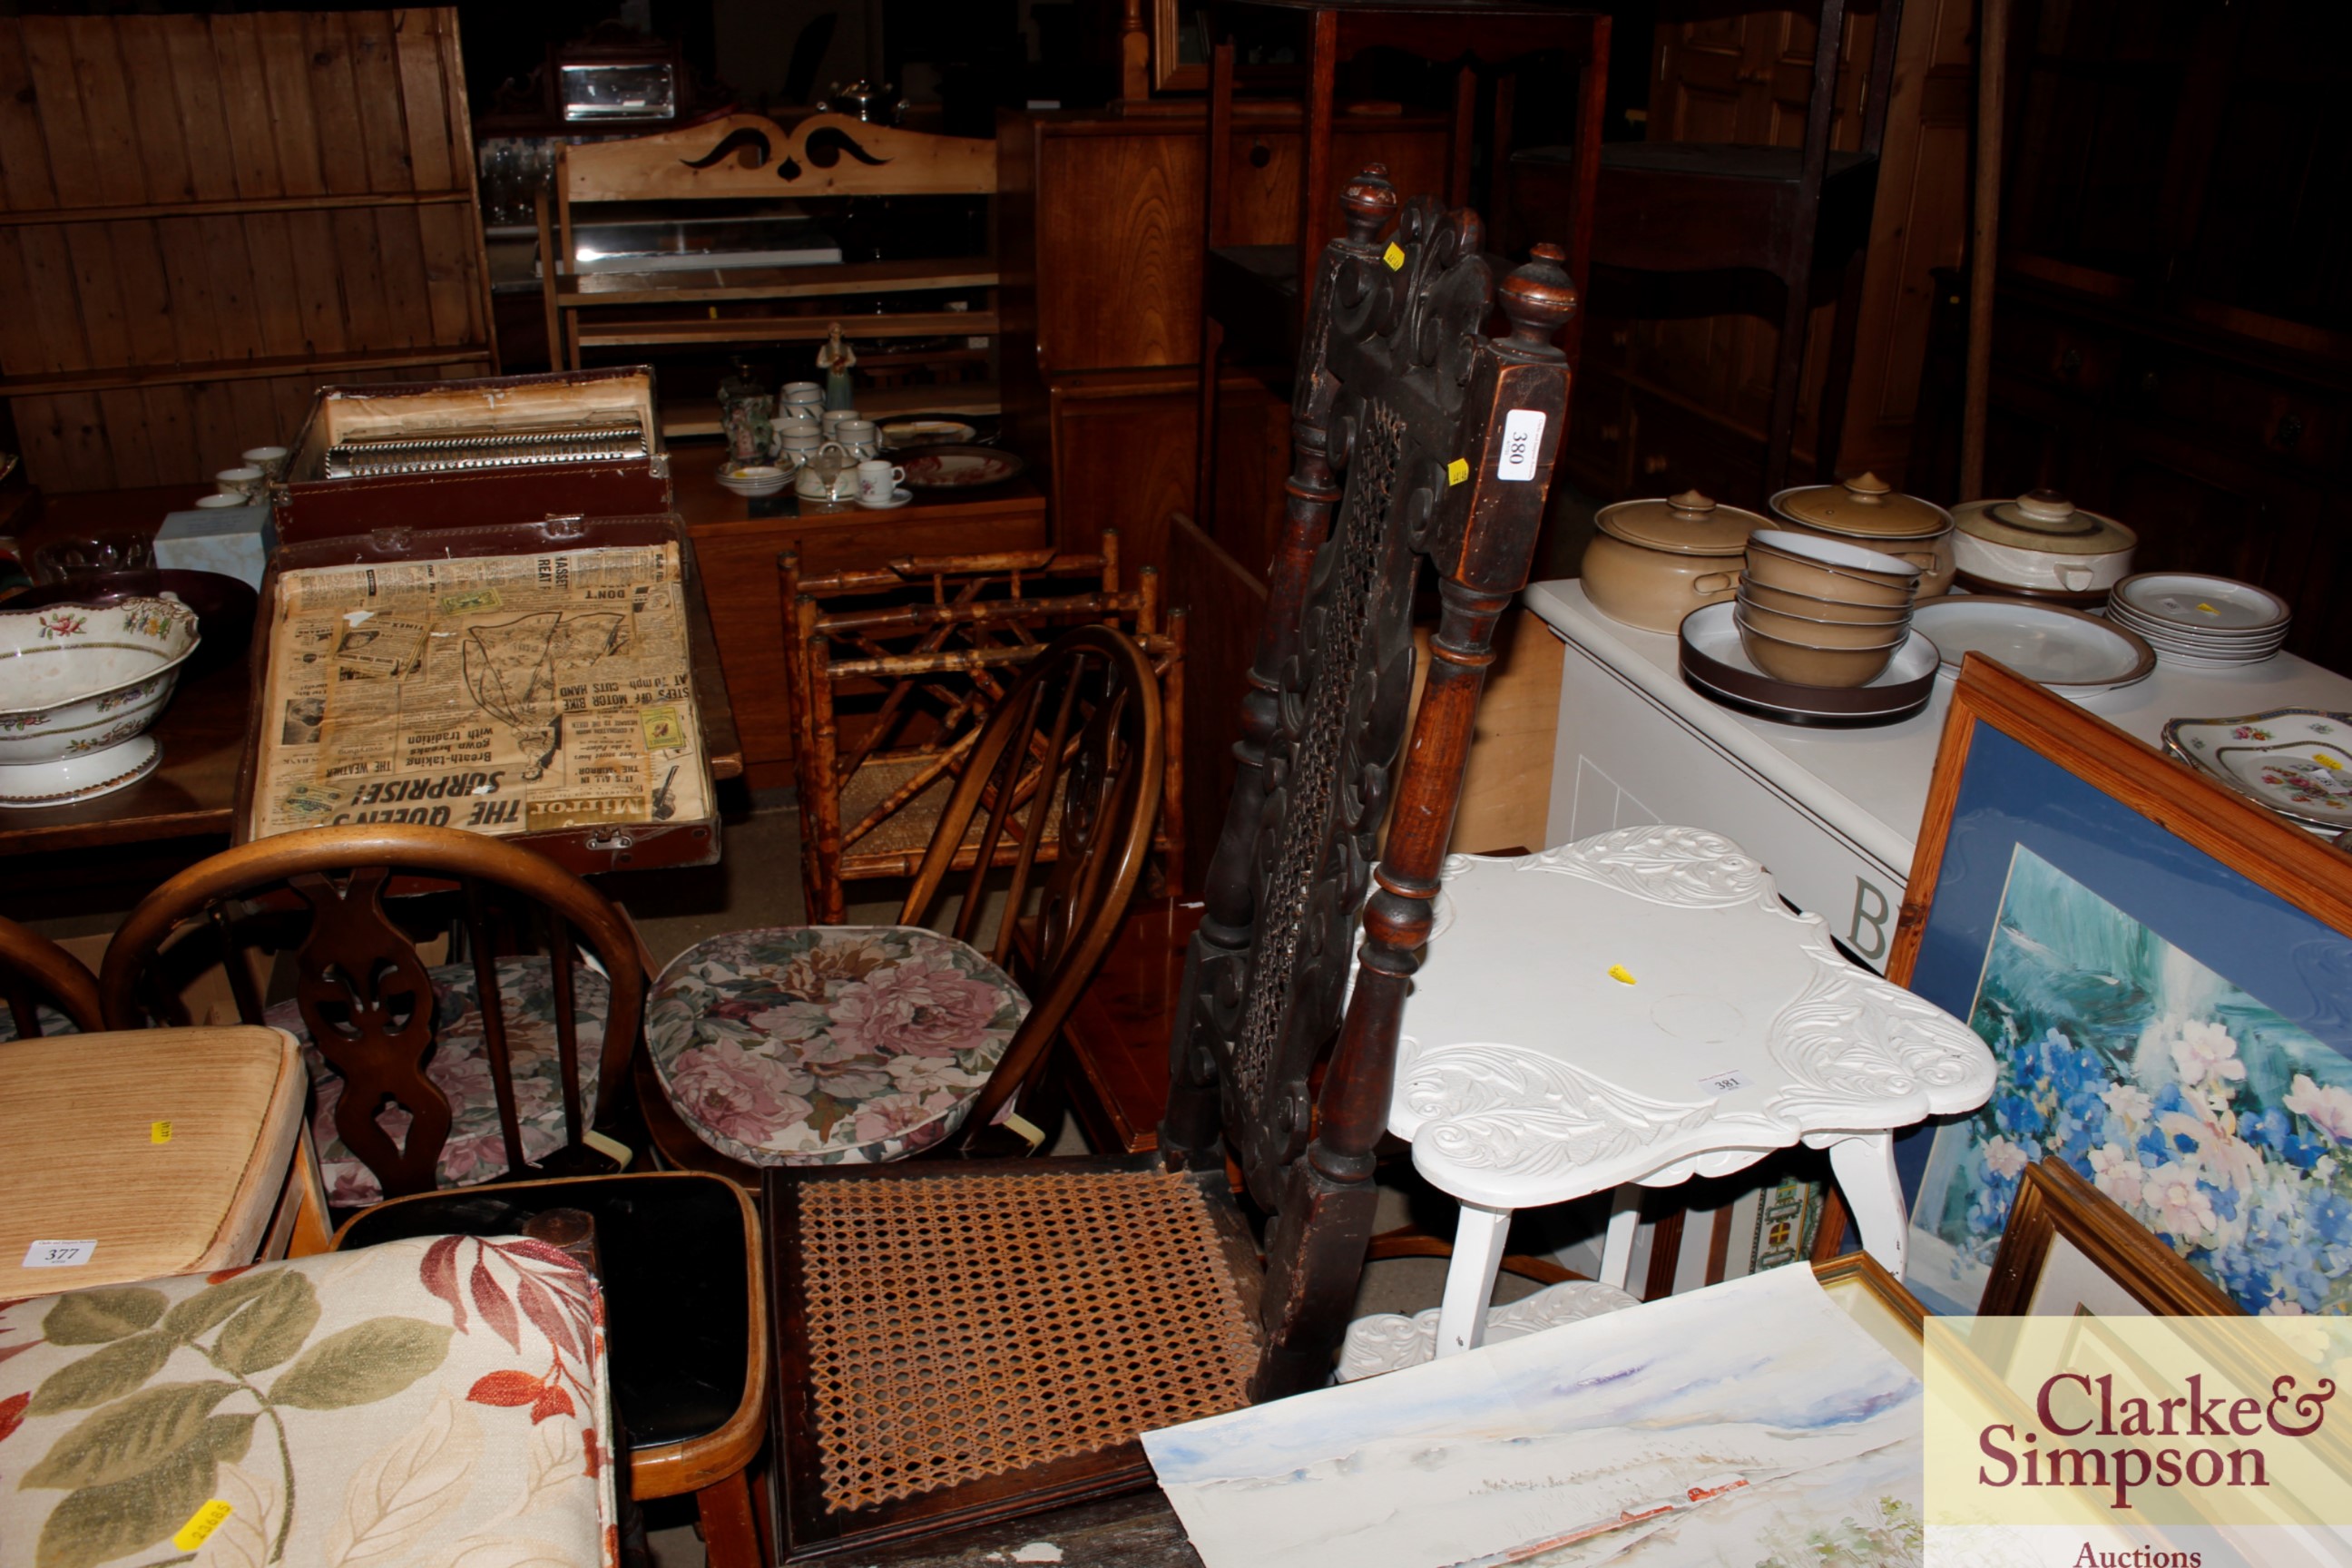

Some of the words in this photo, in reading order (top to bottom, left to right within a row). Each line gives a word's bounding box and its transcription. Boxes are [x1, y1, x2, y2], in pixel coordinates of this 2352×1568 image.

[1509, 432, 1528, 464] 380
[584, 589, 625, 600] DON'T
[392, 622, 424, 631] TIMEX
[593, 681, 619, 693] CUTS
[629, 678, 652, 690] mph
[674, 674, 687, 687] AT
[560, 684, 587, 697] HAND
[658, 687, 689, 700] STEPS
[563, 697, 586, 710] BIKE
[592, 694, 628, 707] MOTOR
[407, 730, 460, 746] tradition
[467, 727, 494, 740] with
[409, 744, 451, 756] breaks
[457, 738, 491, 750] gown
[406, 751, 492, 767] Breath-taking
[326, 762, 368, 778] WEATHER
[374, 760, 391, 773] THE
[622, 765, 639, 773] THE
[580, 776, 590, 784] IN
[594, 775, 611, 784] ALL
[350, 771, 505, 807] SURPRISE!
[466, 799, 521, 827] THE
[529, 797, 642, 816] Mirror
[333, 806, 451, 828] QUEEN
[1847, 875, 1902, 960] B
[1714, 1077, 1740, 1090] 381
[44, 1248, 80, 1260] 377
[191, 1504, 230, 1540] 23685
